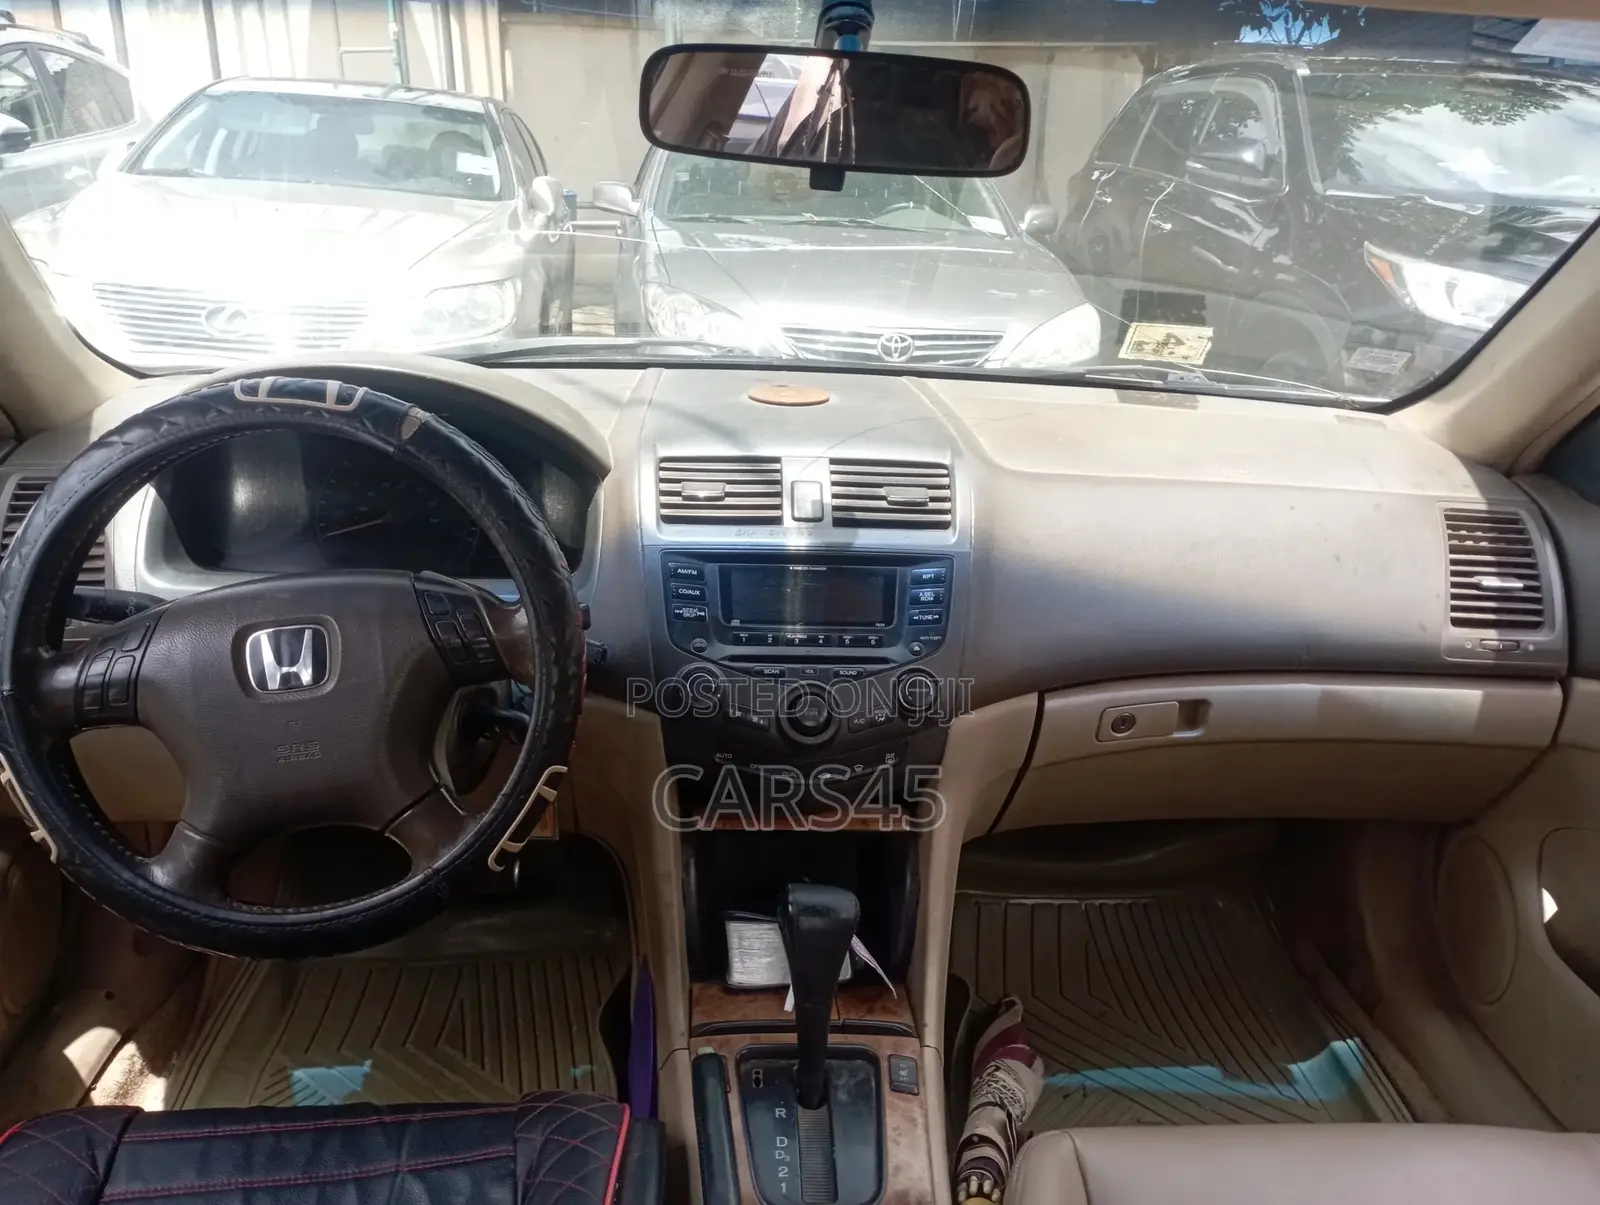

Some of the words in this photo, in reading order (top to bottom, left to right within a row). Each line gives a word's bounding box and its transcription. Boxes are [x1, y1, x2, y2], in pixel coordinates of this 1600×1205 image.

[677, 568, 698, 576] AM/FM
[678, 588, 701, 596] CD/AUX
[774, 1107, 787, 1118] R
[776, 1136, 788, 1147] D
[778, 1166, 789, 1177] 2
[780, 1182, 786, 1194] 1
